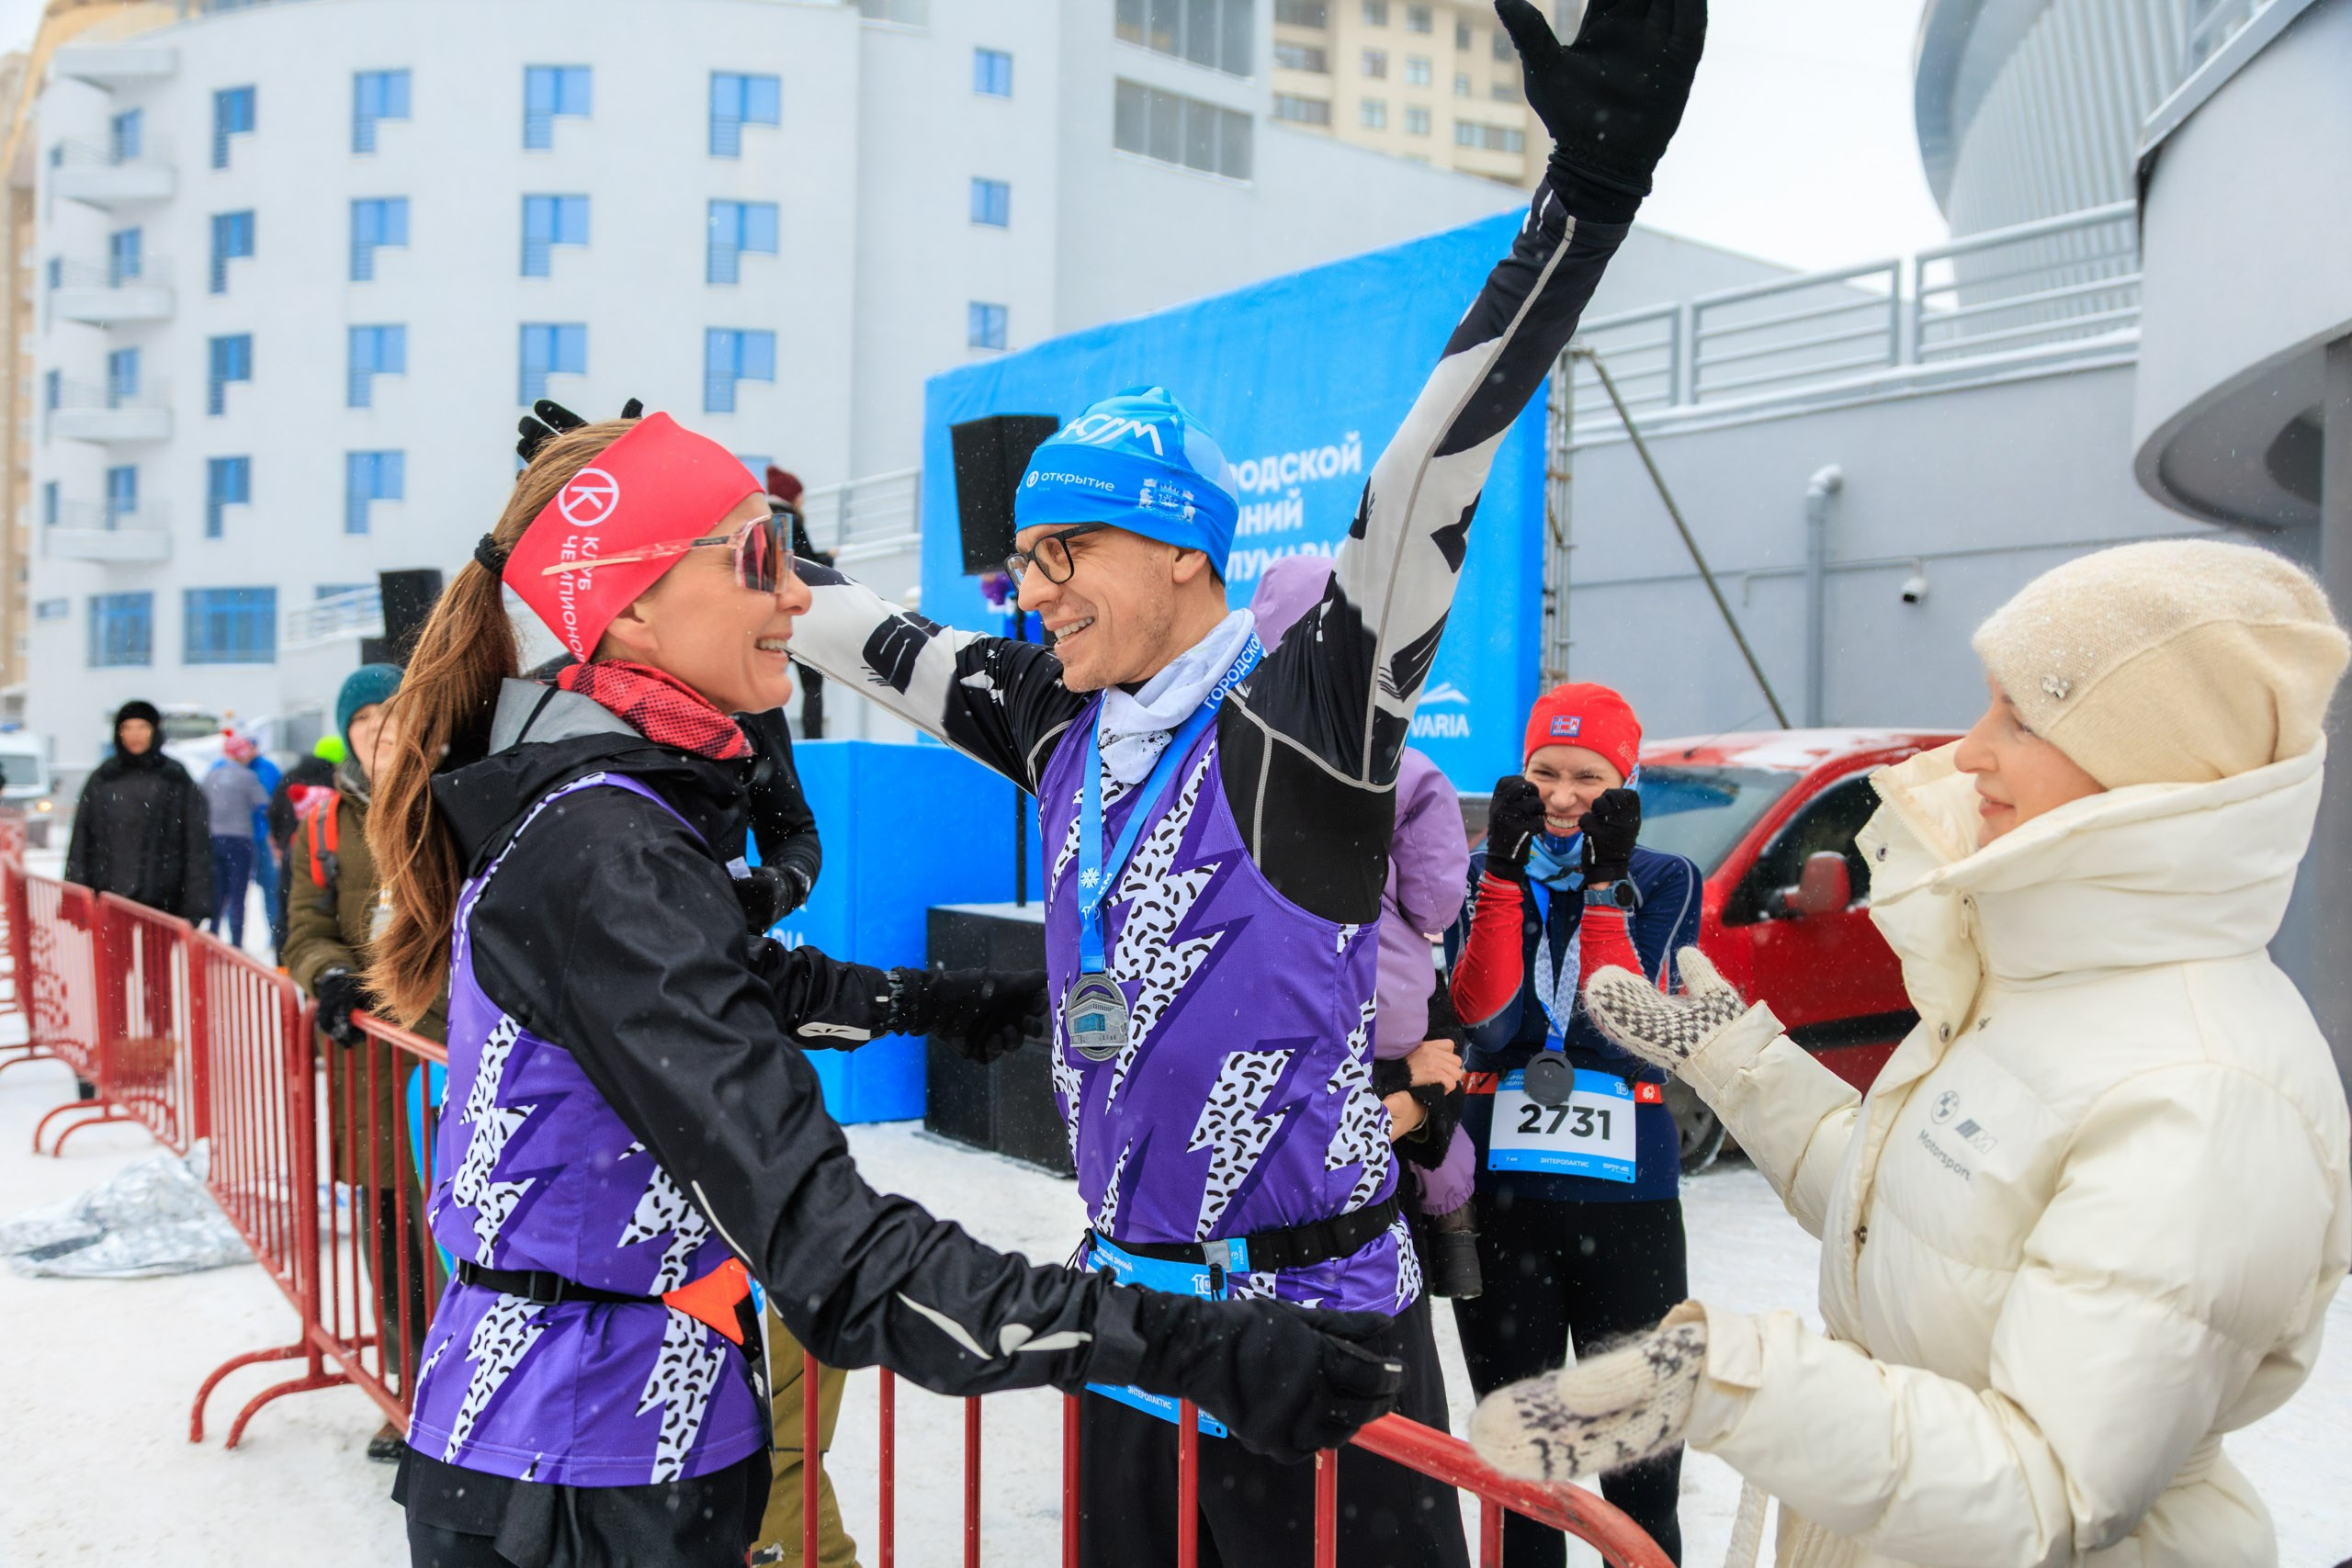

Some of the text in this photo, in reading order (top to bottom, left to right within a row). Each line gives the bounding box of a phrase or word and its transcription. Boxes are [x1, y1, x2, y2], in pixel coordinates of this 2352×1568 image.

[1041, 472, 1115, 491] открытие
[1235, 487, 1304, 537] НИЙ
[1204, 630, 1261, 710] ГОРОДСКОЙ
[1517, 1103, 1611, 1141] 2731
[1540, 1156, 1590, 1168] ЭНТЕРОЛАКТИС
[1918, 1128, 1972, 1181] Motorsport
[1127, 1385, 1172, 1410] ЭНТЕРОЛАКТИС
